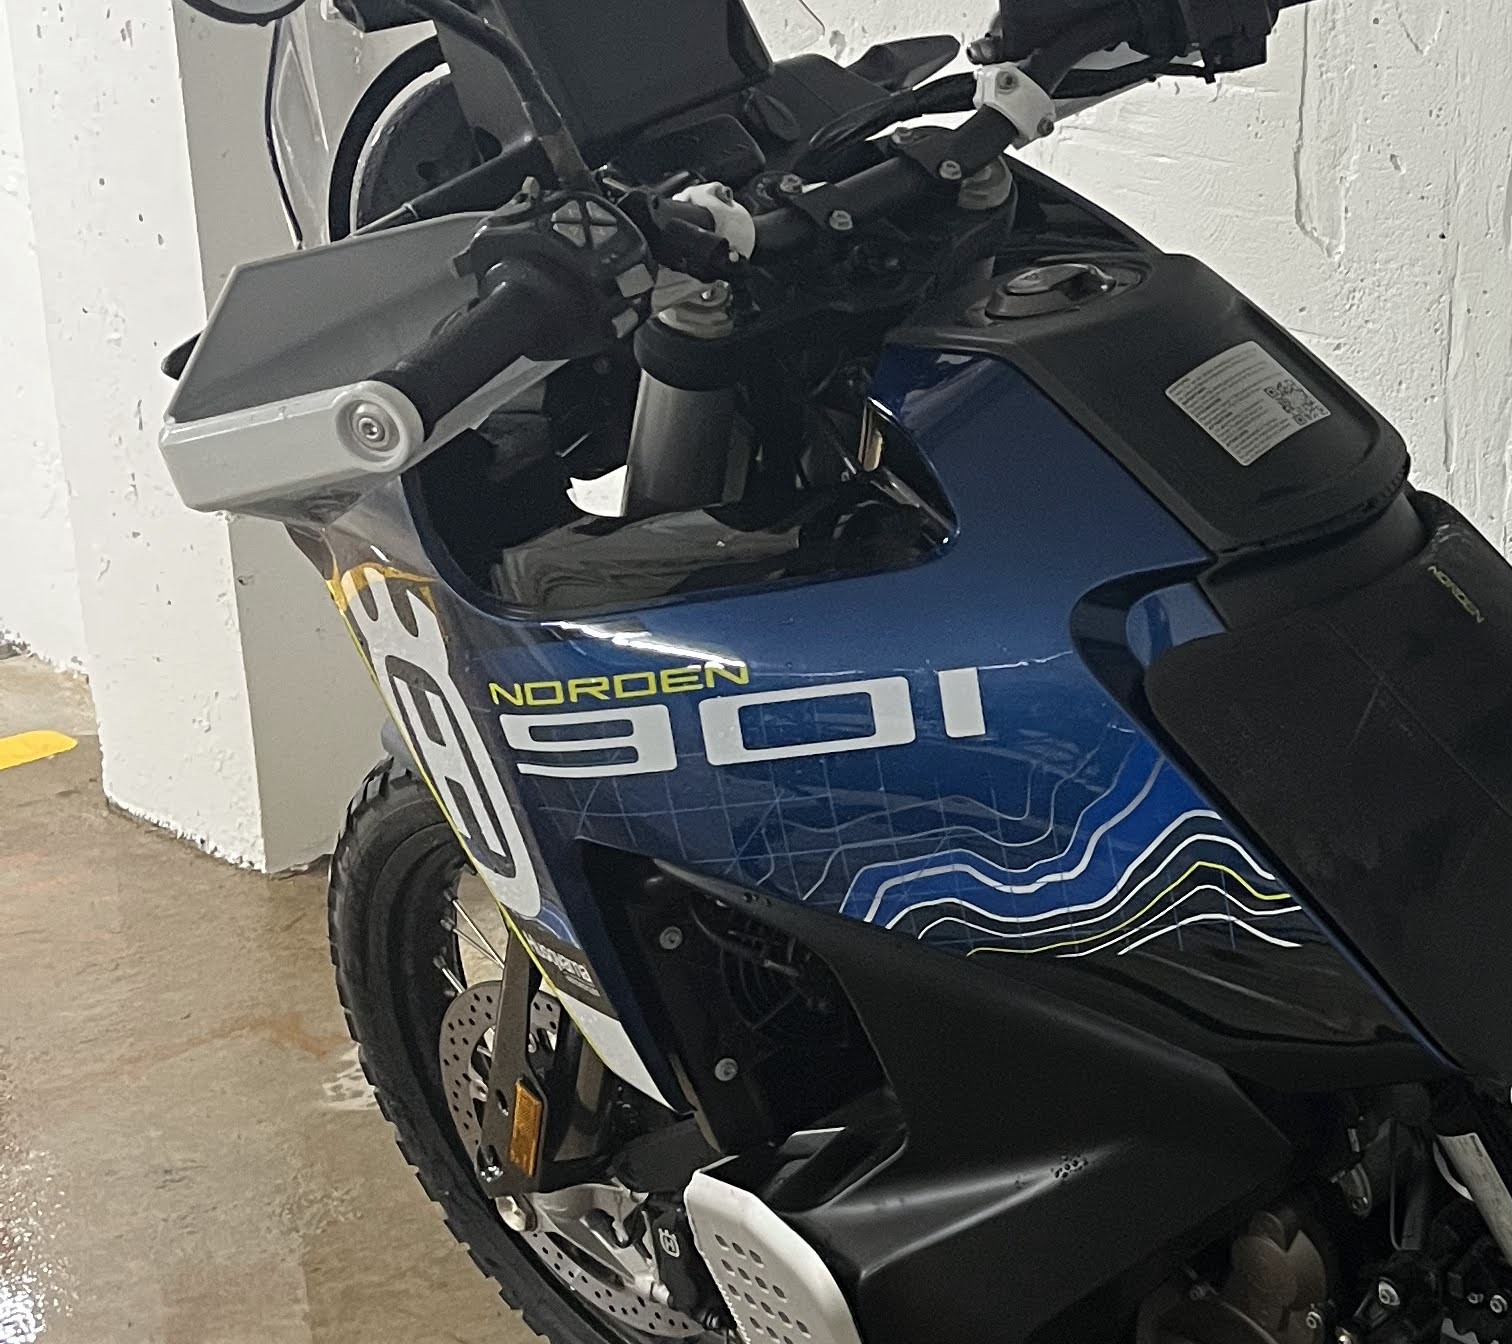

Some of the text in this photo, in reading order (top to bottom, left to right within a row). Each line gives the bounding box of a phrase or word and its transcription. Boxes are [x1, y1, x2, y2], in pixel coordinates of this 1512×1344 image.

[1428, 565, 1485, 623] NORDEN
[488, 662, 749, 706] NORDEN
[499, 667, 986, 778] 901
